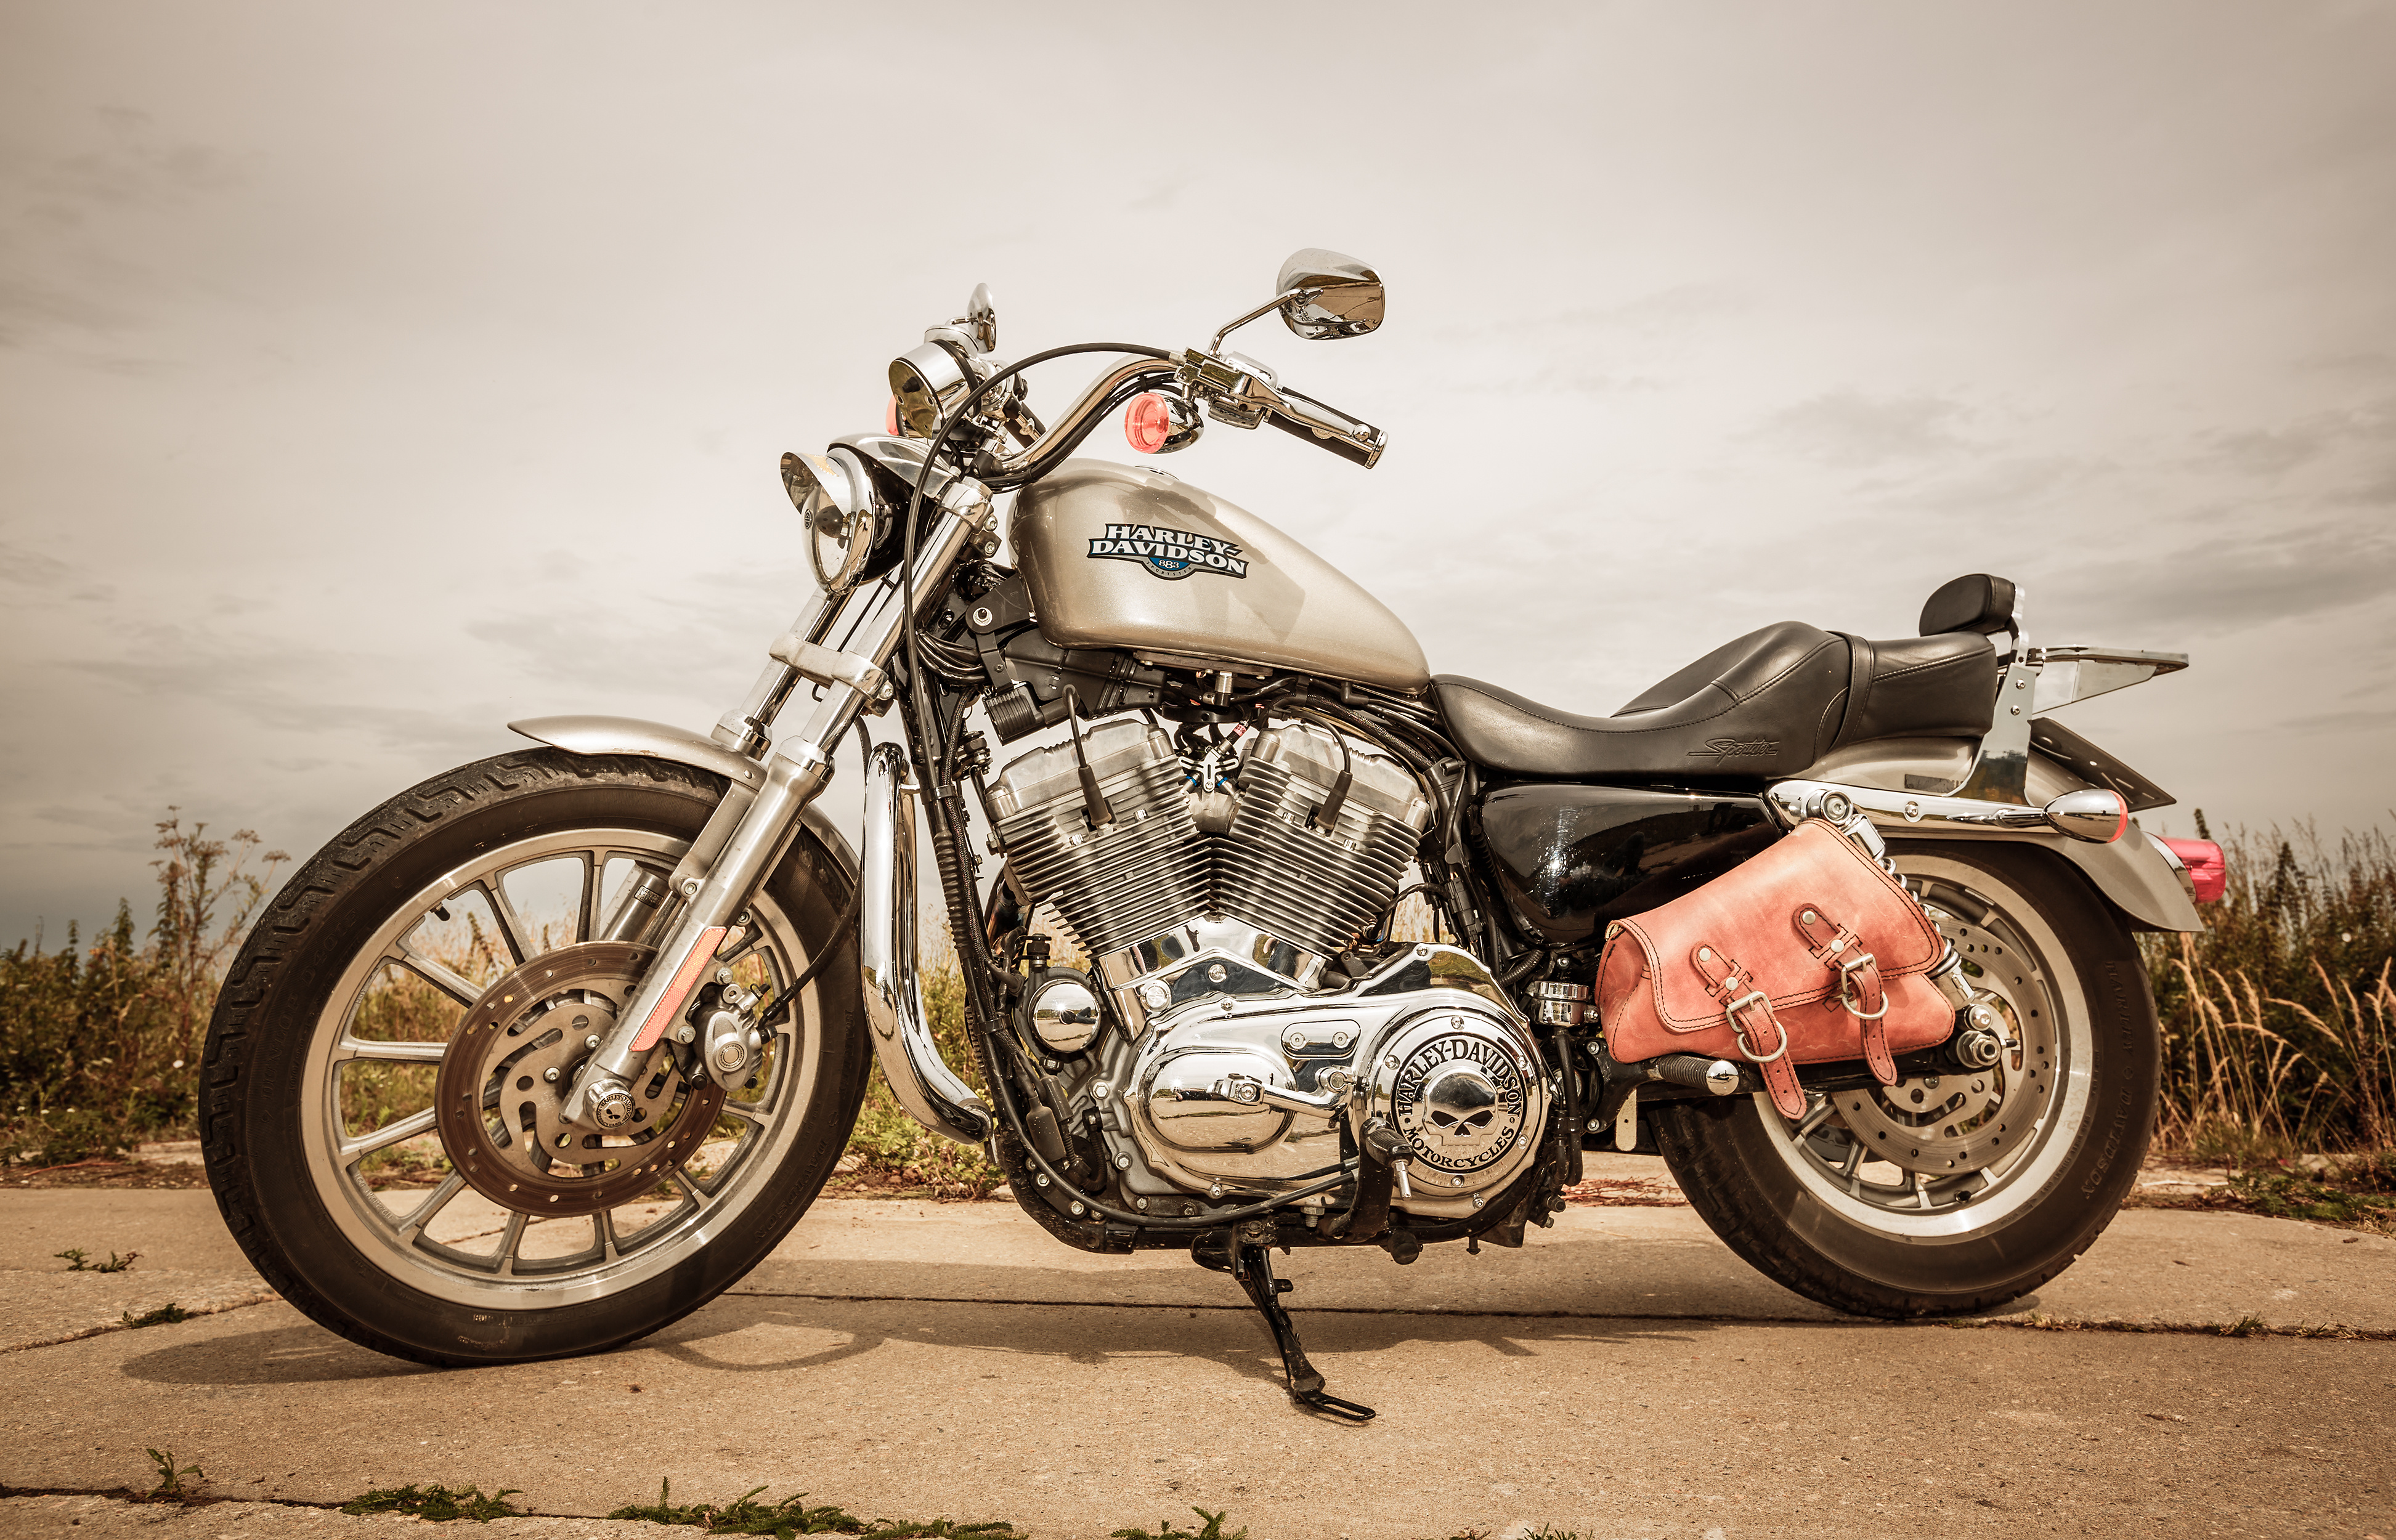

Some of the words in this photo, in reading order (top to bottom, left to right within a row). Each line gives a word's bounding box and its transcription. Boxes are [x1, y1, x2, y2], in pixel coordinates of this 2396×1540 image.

[1091, 540, 1245, 575] DAVIDSON
[1146, 561, 1192, 576] SPORTSTER
[1158, 559, 1179, 569] 883
[261, 992, 299, 1100] DUNLOP
[2104, 960, 2134, 1057] HARLEY
[837, 1009, 855, 1101] HARLEY
[1397, 1038, 1523, 1119] HARLEY-DAVIDSON
[1403, 1126, 1515, 1168] MOTORCYCLES
[2080, 1087, 2132, 1200] DAVIDSON
[755, 1139, 827, 1244] DAVIDSON
